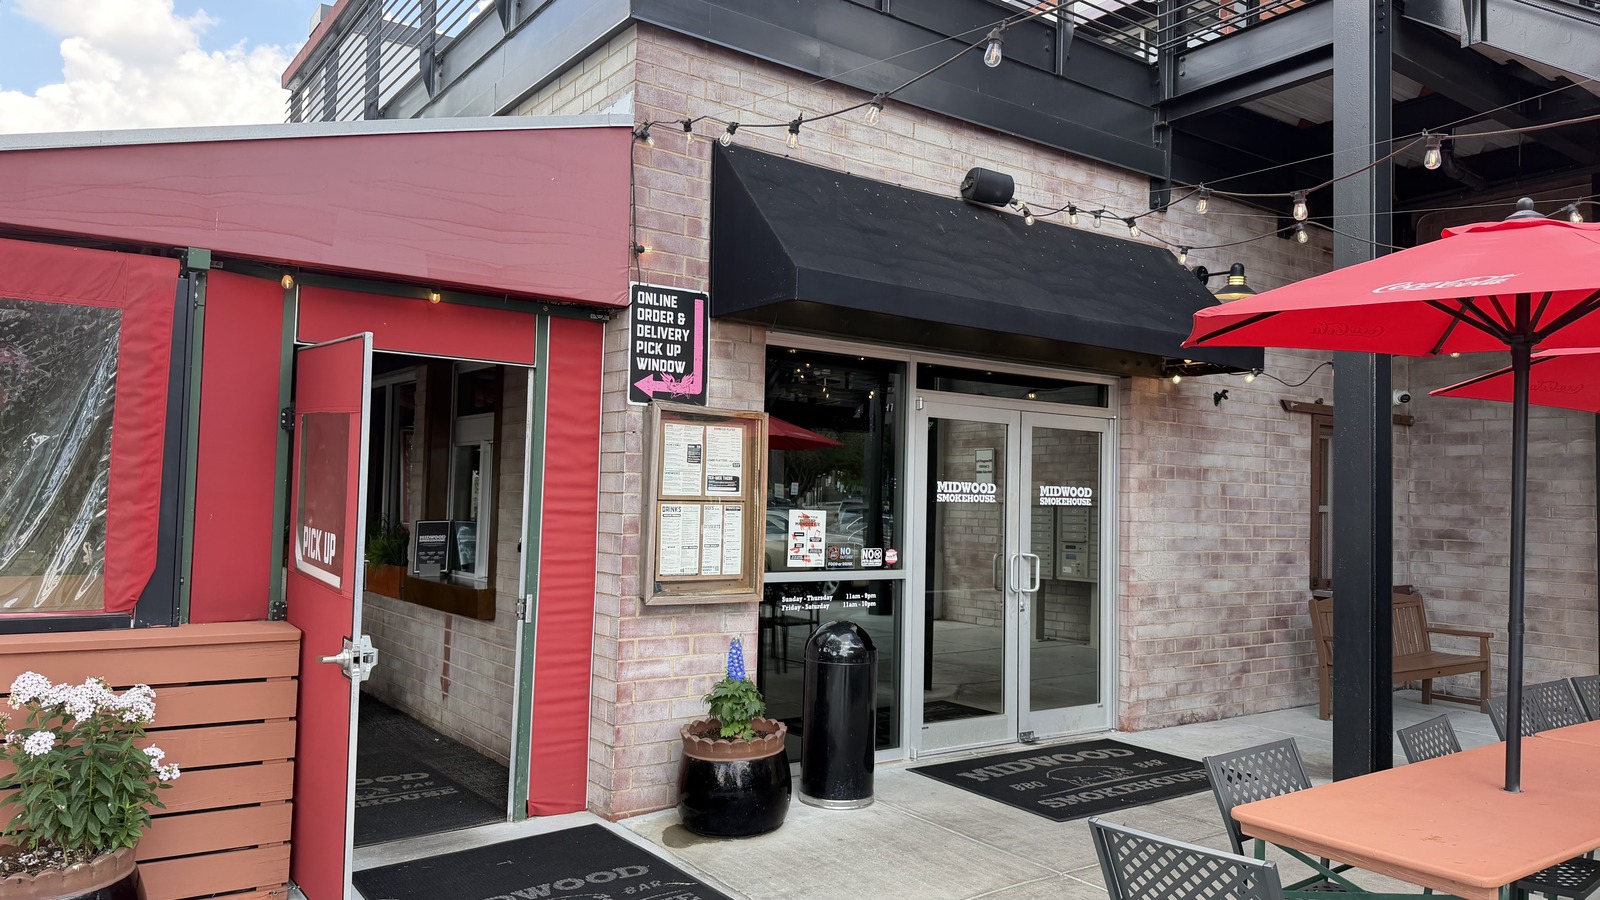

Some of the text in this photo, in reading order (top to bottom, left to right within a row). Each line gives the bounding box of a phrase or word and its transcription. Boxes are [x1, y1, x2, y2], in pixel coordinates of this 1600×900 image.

[637, 291, 678, 308] ONLINE
[637, 307, 686, 325] ORDER &
[636, 324, 690, 342] DELIVERY
[636, 341, 682, 357] PICK UP
[636, 357, 686, 373] WINDOW
[936, 481, 997, 494] MIDWOOD
[1039, 485, 1092, 498] MIDWOOD
[303, 525, 336, 566] PICK UP
[840, 547, 851, 555] NO
[862, 549, 874, 560] NO
[781, 595, 803, 603] Sunday
[807, 594, 833, 602] Thursday
[781, 604, 801, 612] Friday
[805, 602, 830, 610] Saturday
[956, 748, 1135, 782] MIDWOOD
[1133, 759, 1168, 769] BAR
[1009, 780, 1048, 791] BBQ
[1038, 768, 1208, 808] SMOKEHOUS
[622, 880, 661, 895] BAR
